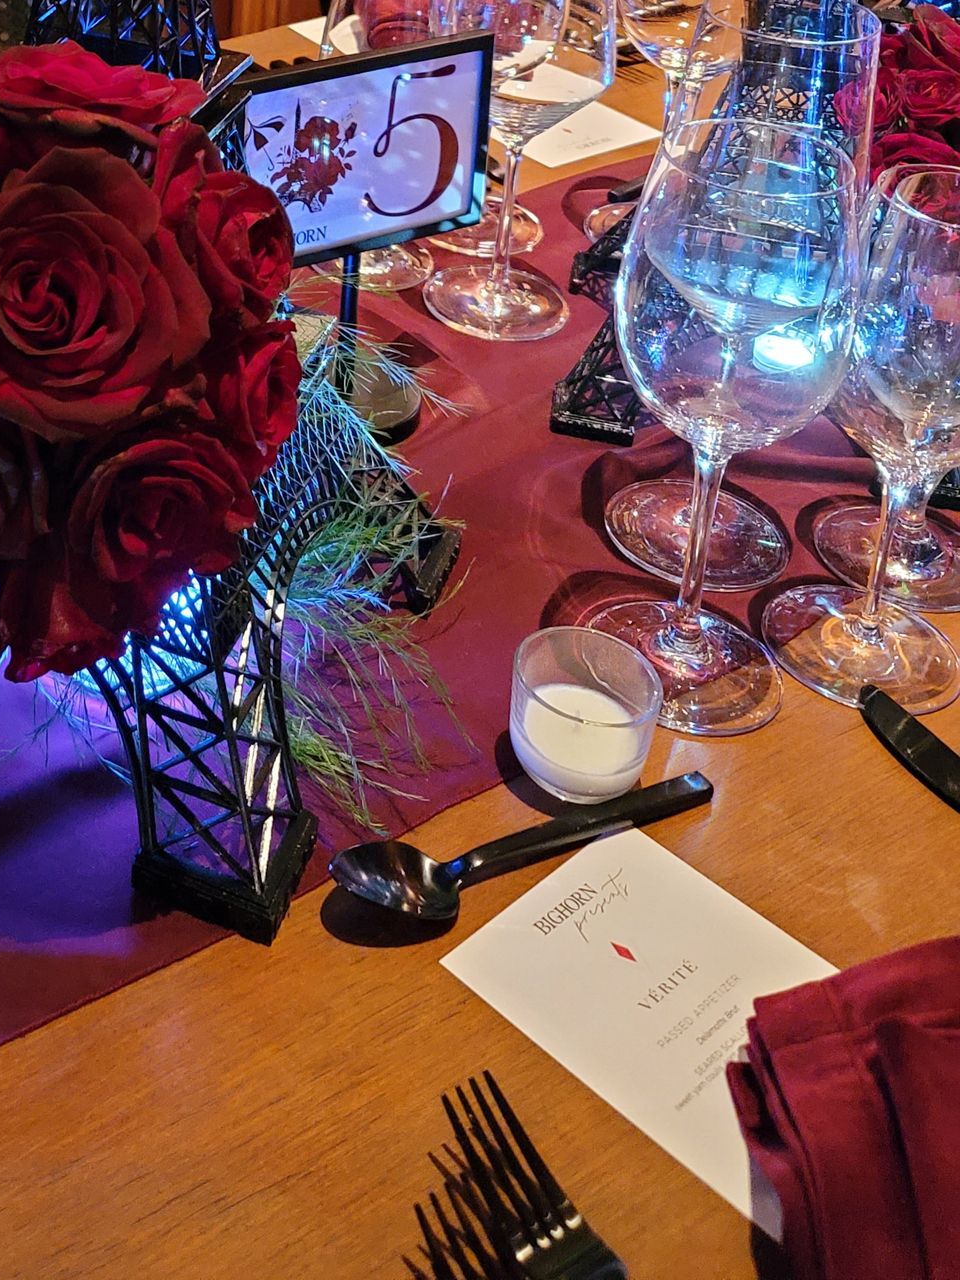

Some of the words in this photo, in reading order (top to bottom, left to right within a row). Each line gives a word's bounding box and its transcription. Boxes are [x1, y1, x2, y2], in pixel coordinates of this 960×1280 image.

[363, 63, 459, 217] 5
[294, 224, 328, 246] ORN
[533, 883, 599, 936] BIGHORN
[573, 867, 629, 944] presents
[637, 958, 699, 1010] VÉRITÉ
[656, 1016, 694, 1049] PASSED
[693, 973, 741, 1018] APPETIZER
[693, 1048, 724, 1077] SEARED
